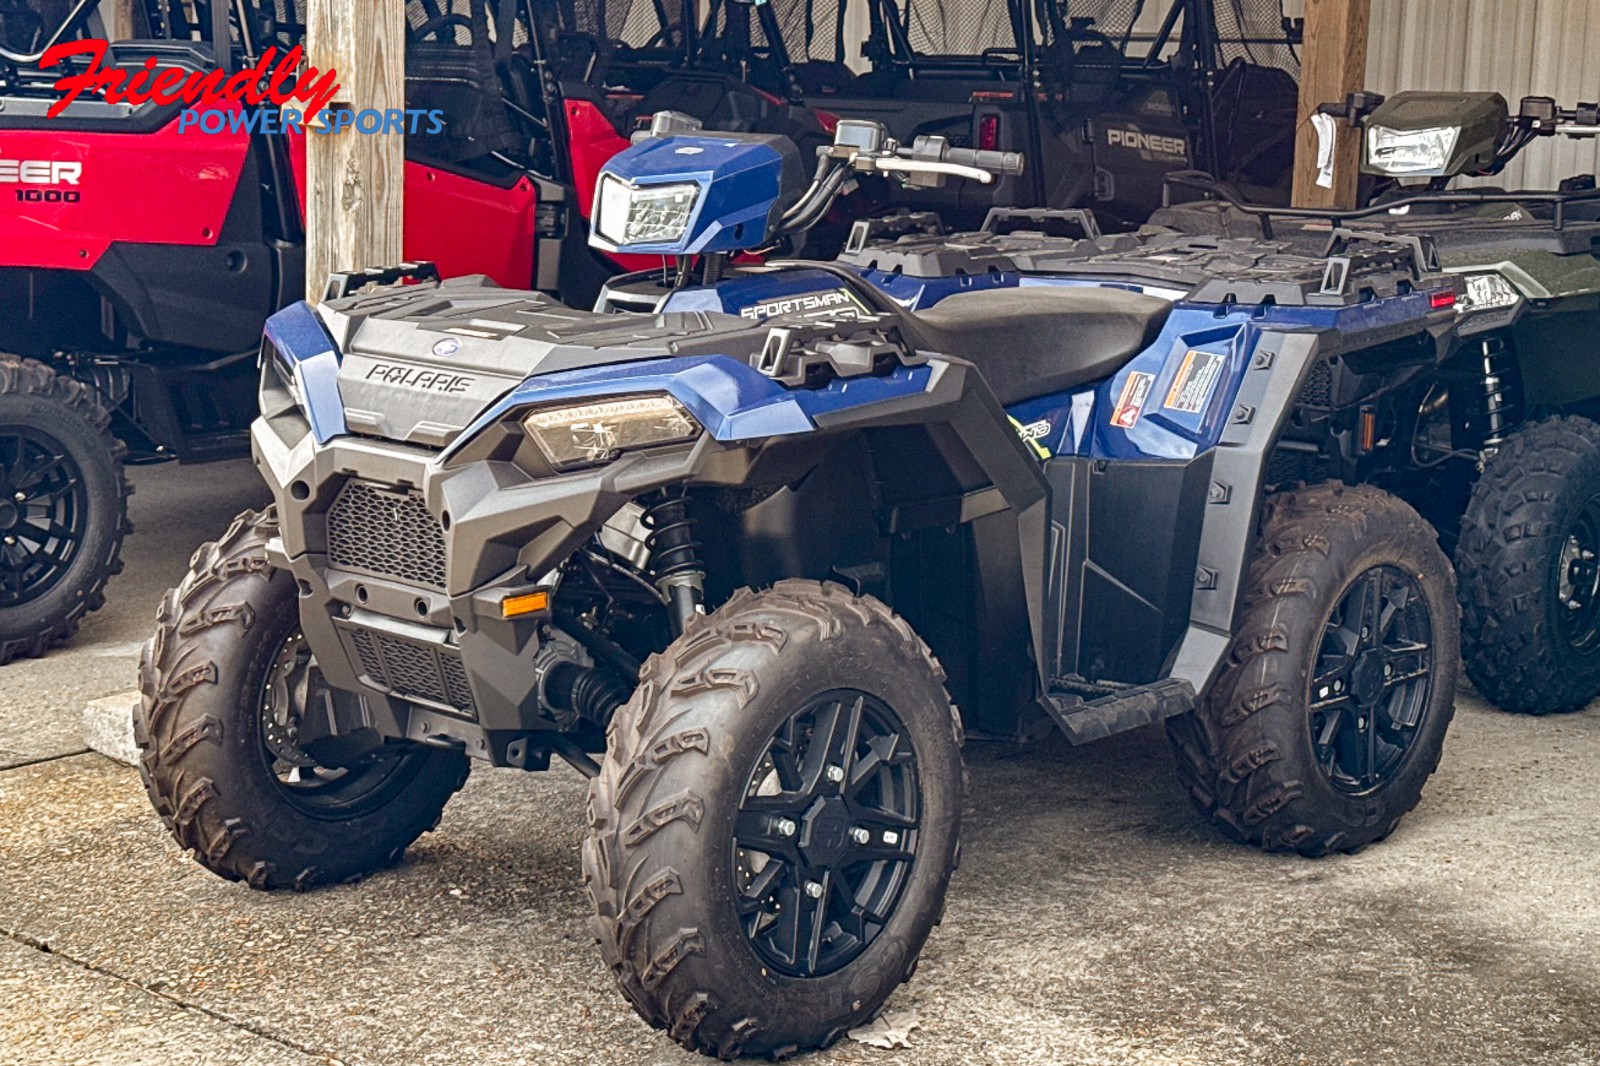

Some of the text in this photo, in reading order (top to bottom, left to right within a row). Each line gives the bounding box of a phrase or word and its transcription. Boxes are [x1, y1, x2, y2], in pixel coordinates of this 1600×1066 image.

[1106, 128, 1186, 156] PIONEER
[15, 189, 81, 203] 1000
[740, 292, 850, 319] SPORTSMAN
[364, 363, 476, 393] POLARIS
